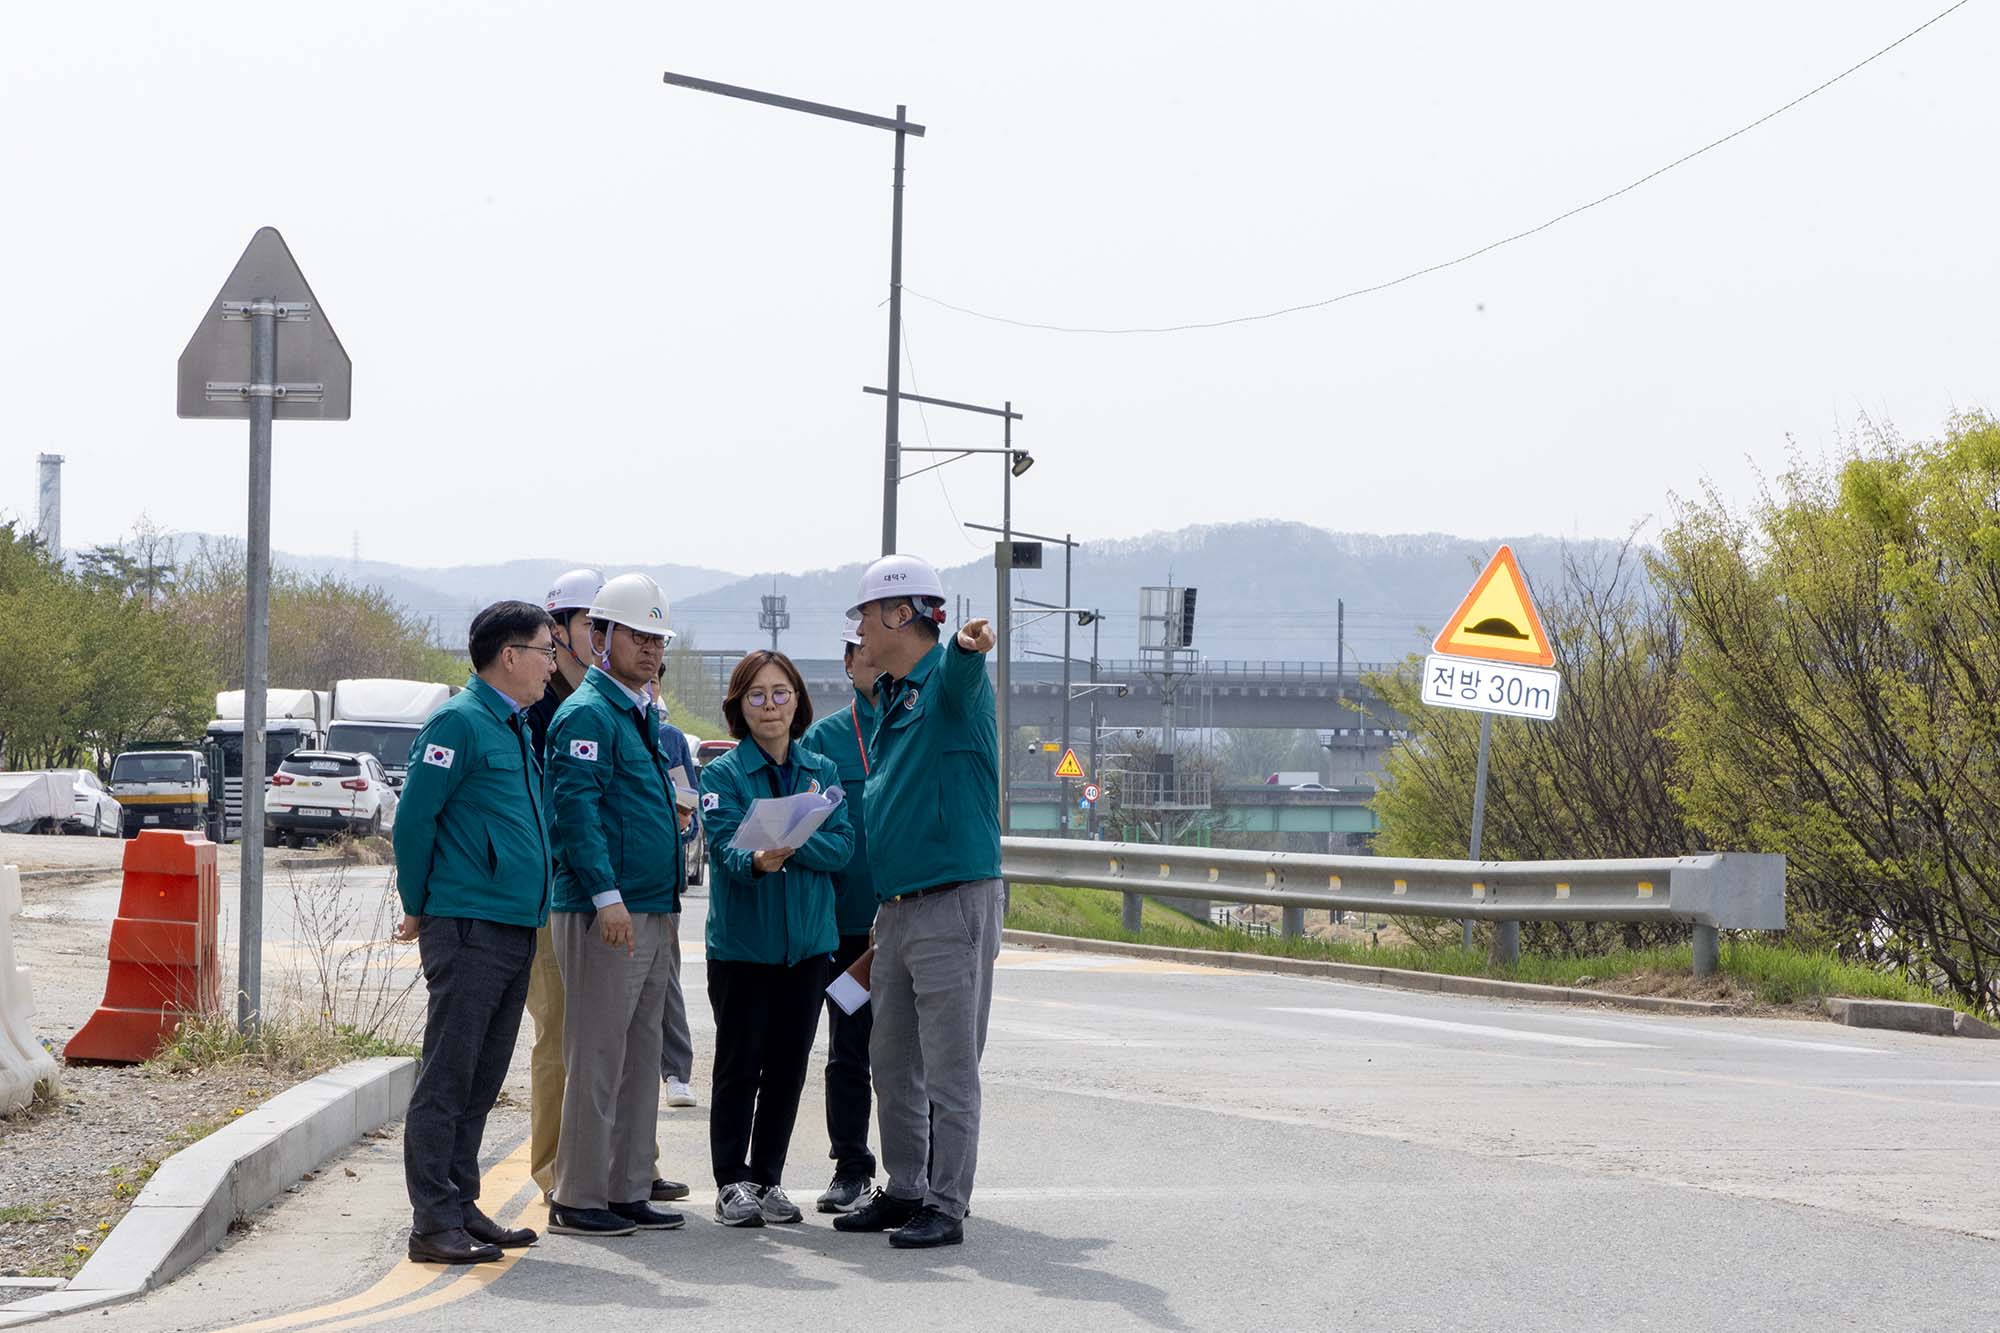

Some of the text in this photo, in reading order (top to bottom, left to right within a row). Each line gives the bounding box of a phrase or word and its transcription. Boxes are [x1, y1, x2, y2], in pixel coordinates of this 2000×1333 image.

[884, 573, 906, 582] 대덕구
[1433, 667, 1550, 710] 전방 30m
[1086, 788, 1096, 798] 40
